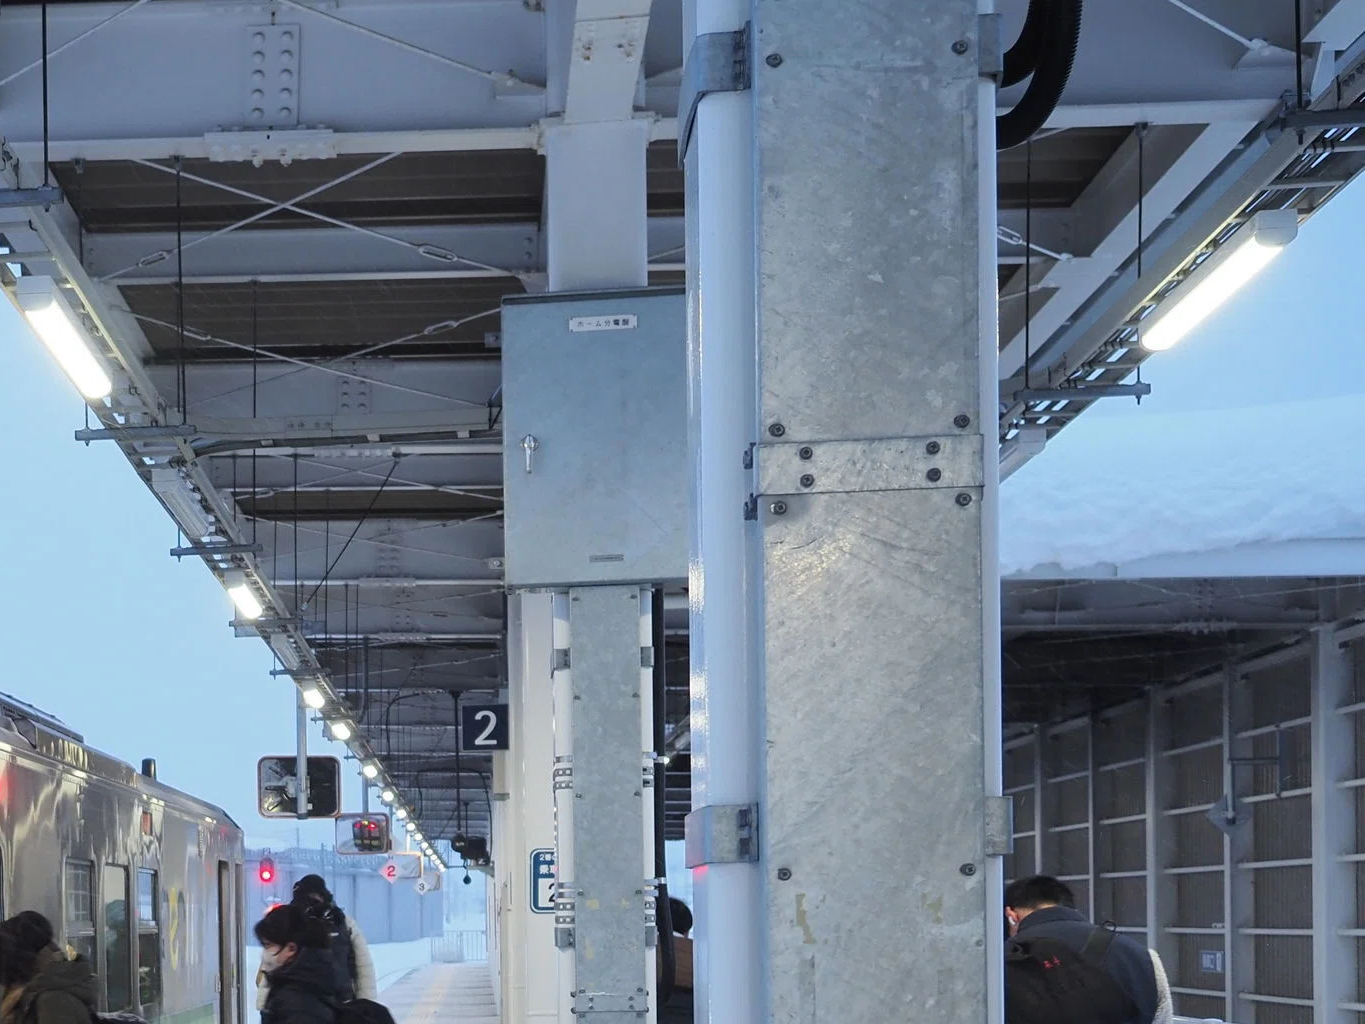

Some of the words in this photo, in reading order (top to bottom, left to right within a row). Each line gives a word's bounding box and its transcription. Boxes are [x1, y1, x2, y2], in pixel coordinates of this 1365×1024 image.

[474, 710, 498, 746] 2
[387, 865, 396, 877] 2
[418, 882, 425, 891] 3
